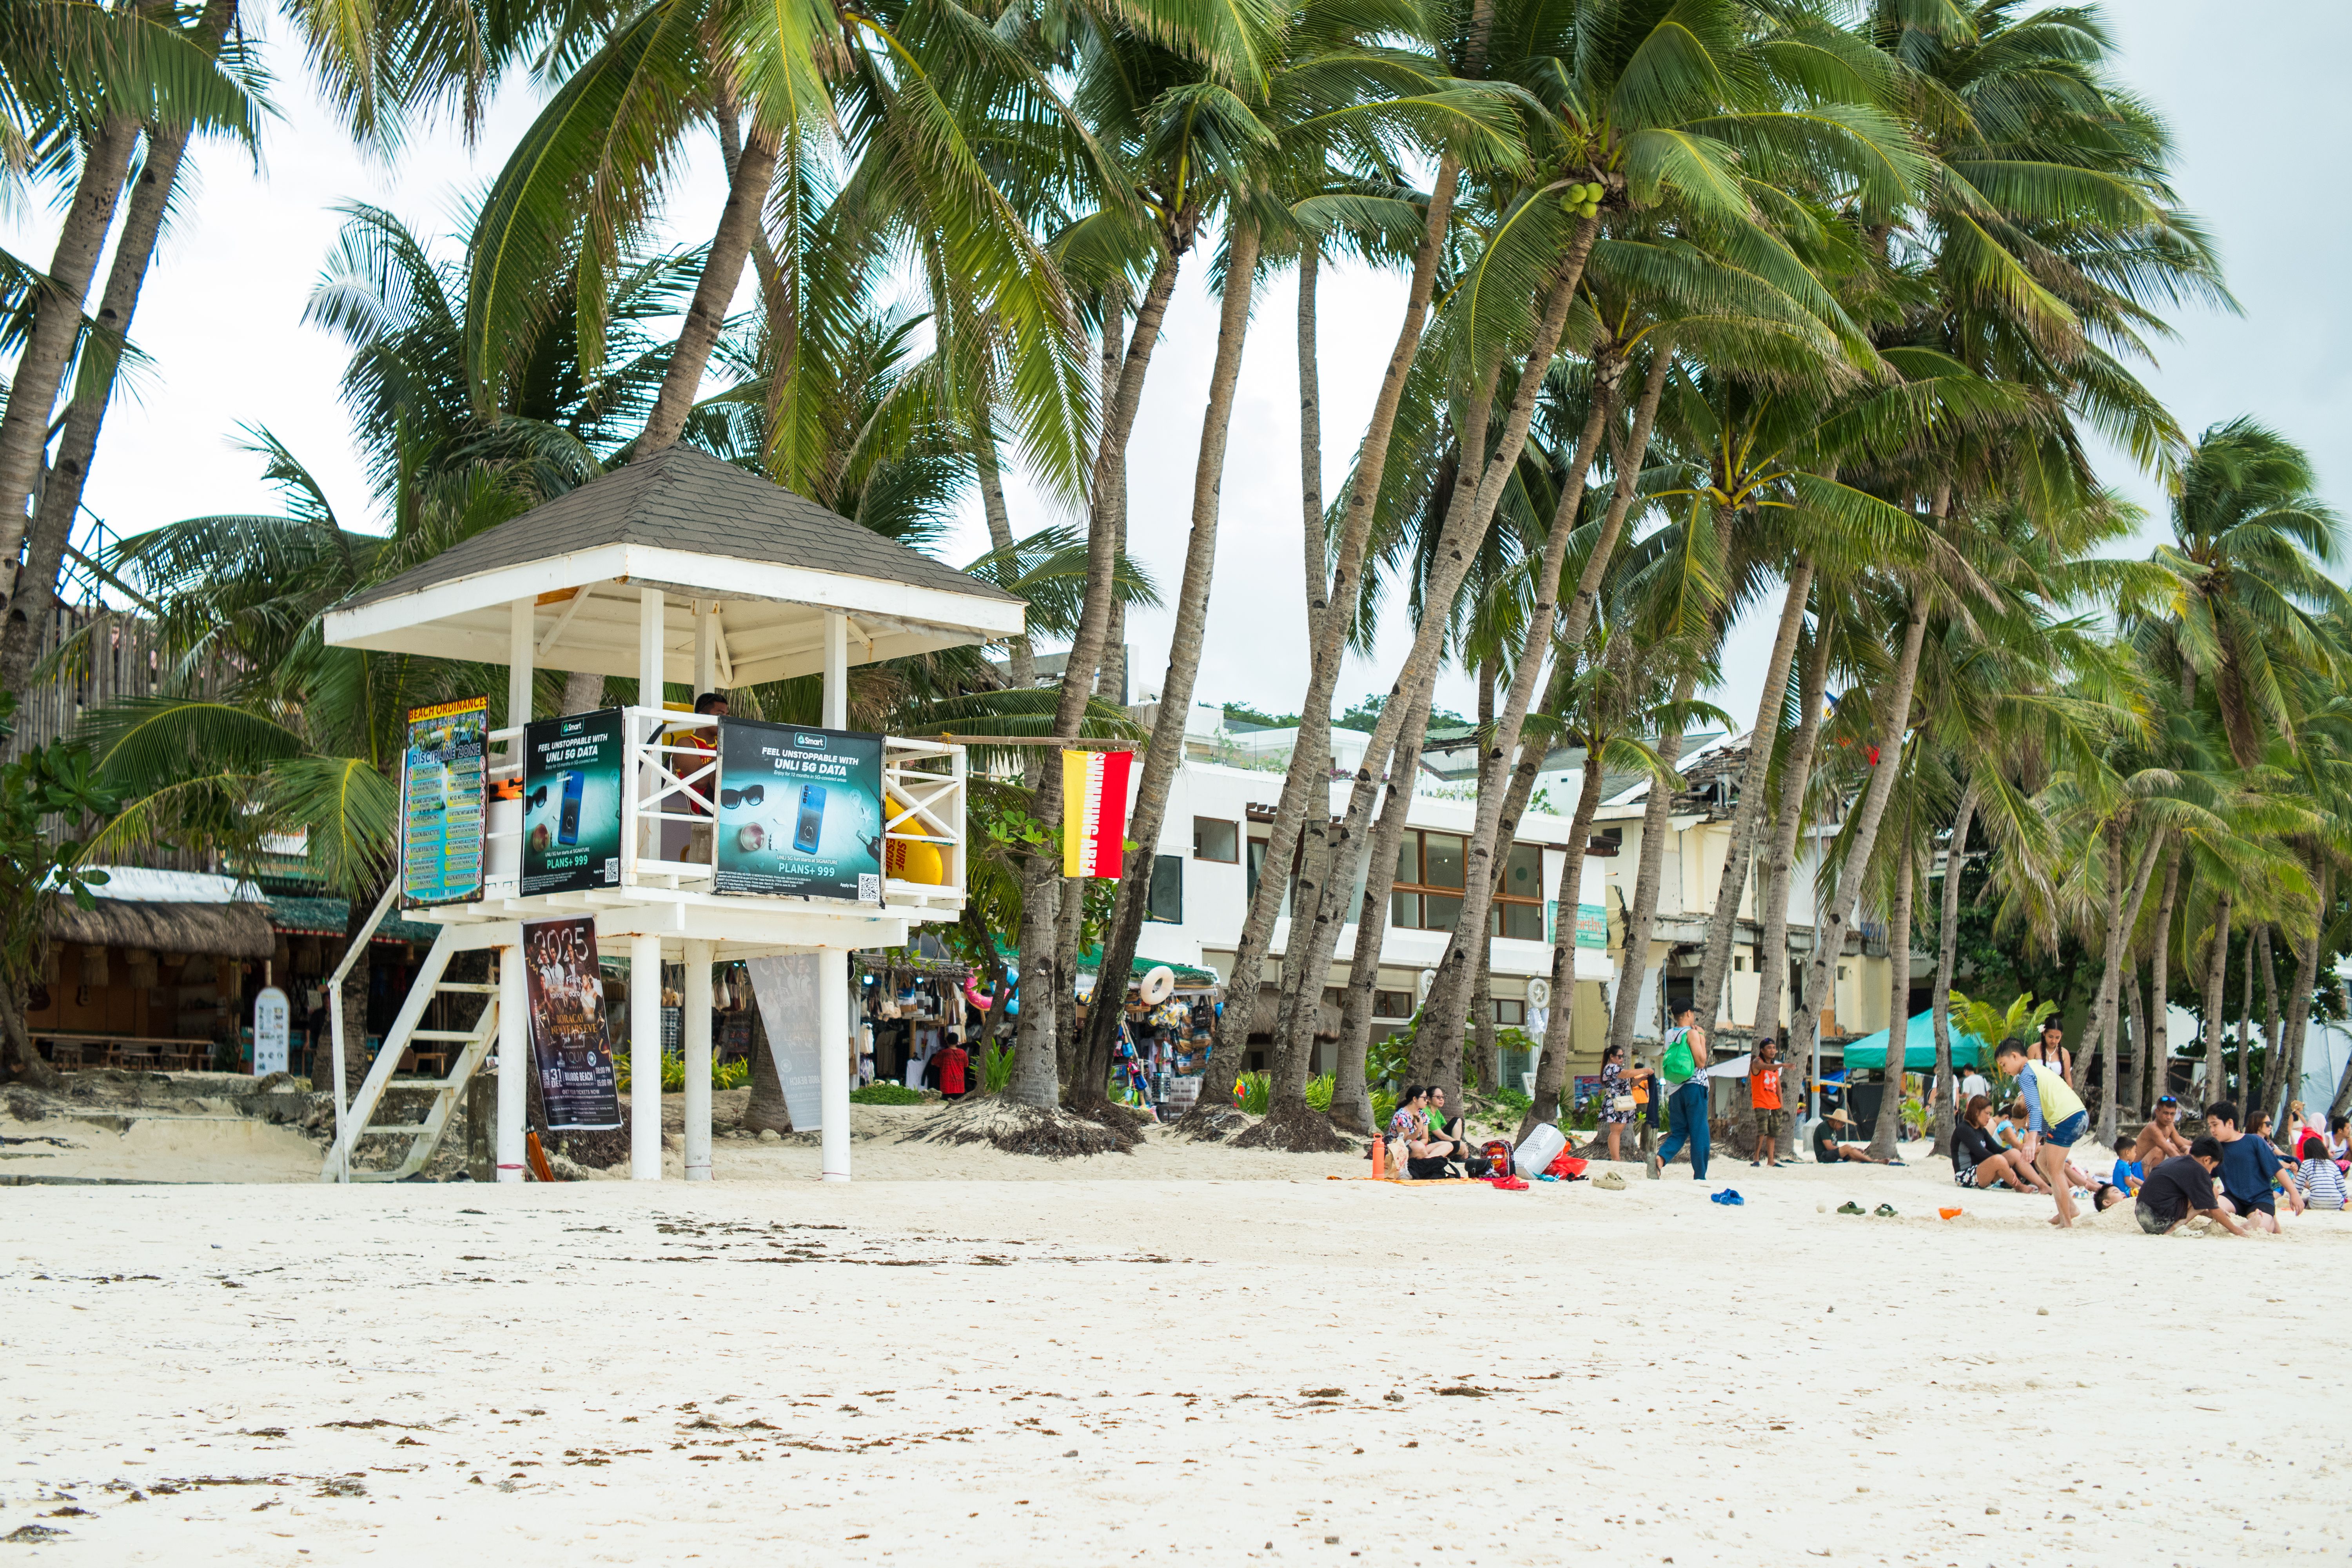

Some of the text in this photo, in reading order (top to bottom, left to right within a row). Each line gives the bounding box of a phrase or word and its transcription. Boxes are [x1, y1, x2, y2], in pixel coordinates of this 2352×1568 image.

[409, 697, 487, 720] BEACH ORDINANCES
[466, 713, 479, 721] MAKE
[568, 722, 581, 731] Smart
[538, 733, 608, 752] FEEL UNSTOPPABLE WITH
[805, 737, 823, 746] Smart
[412, 743, 481, 764] DISCIPLINE ZONE
[546, 745, 598, 763] UNLI 5G DATA
[762, 747, 859, 765] FEEL UNSTOPPABLE WITH
[775, 758, 847, 776] UNLI 5G DATA
[1079, 752, 1107, 877] SWIMMING AREA
[547, 855, 588, 869] PLANS+ 999
[886, 838, 895, 872] ESCUE
[895, 841, 907, 872] SURF
[779, 862, 835, 877] PLANS+ 999
[534, 927, 588, 964] 2025
[556, 1014, 584, 1024] BORACAY
[551, 1023, 597, 1034] NEW YEARS EVE
[550, 1068, 561, 1081] 31
[579, 1071, 593, 1081] BEACH
[551, 1080, 563, 1088] DEC
